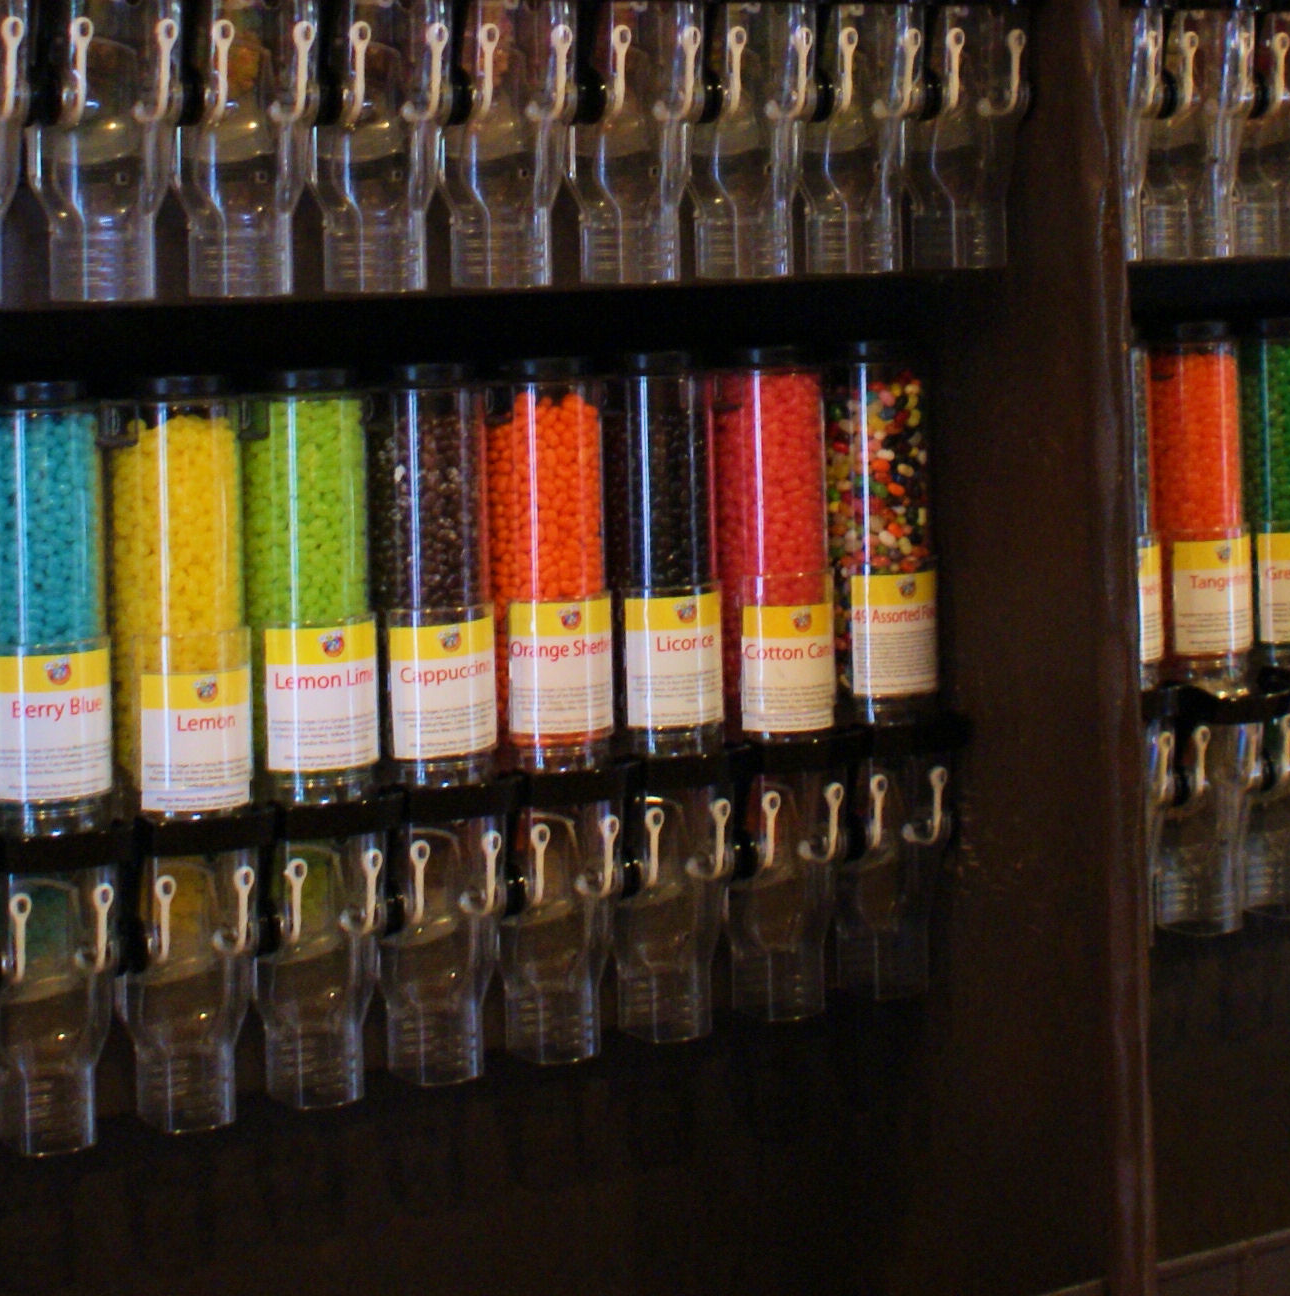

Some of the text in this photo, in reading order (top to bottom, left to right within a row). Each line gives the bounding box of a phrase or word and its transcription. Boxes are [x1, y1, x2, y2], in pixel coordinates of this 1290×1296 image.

[853, 608, 868, 625] 49
[872, 606, 920, 624] Assorted
[510, 640, 569, 663] Orange
[744, 643, 804, 661] Cotton
[274, 669, 341, 692] Lemon
[12, 696, 103, 723] Berry Blue
[177, 712, 237, 733] Lemon
